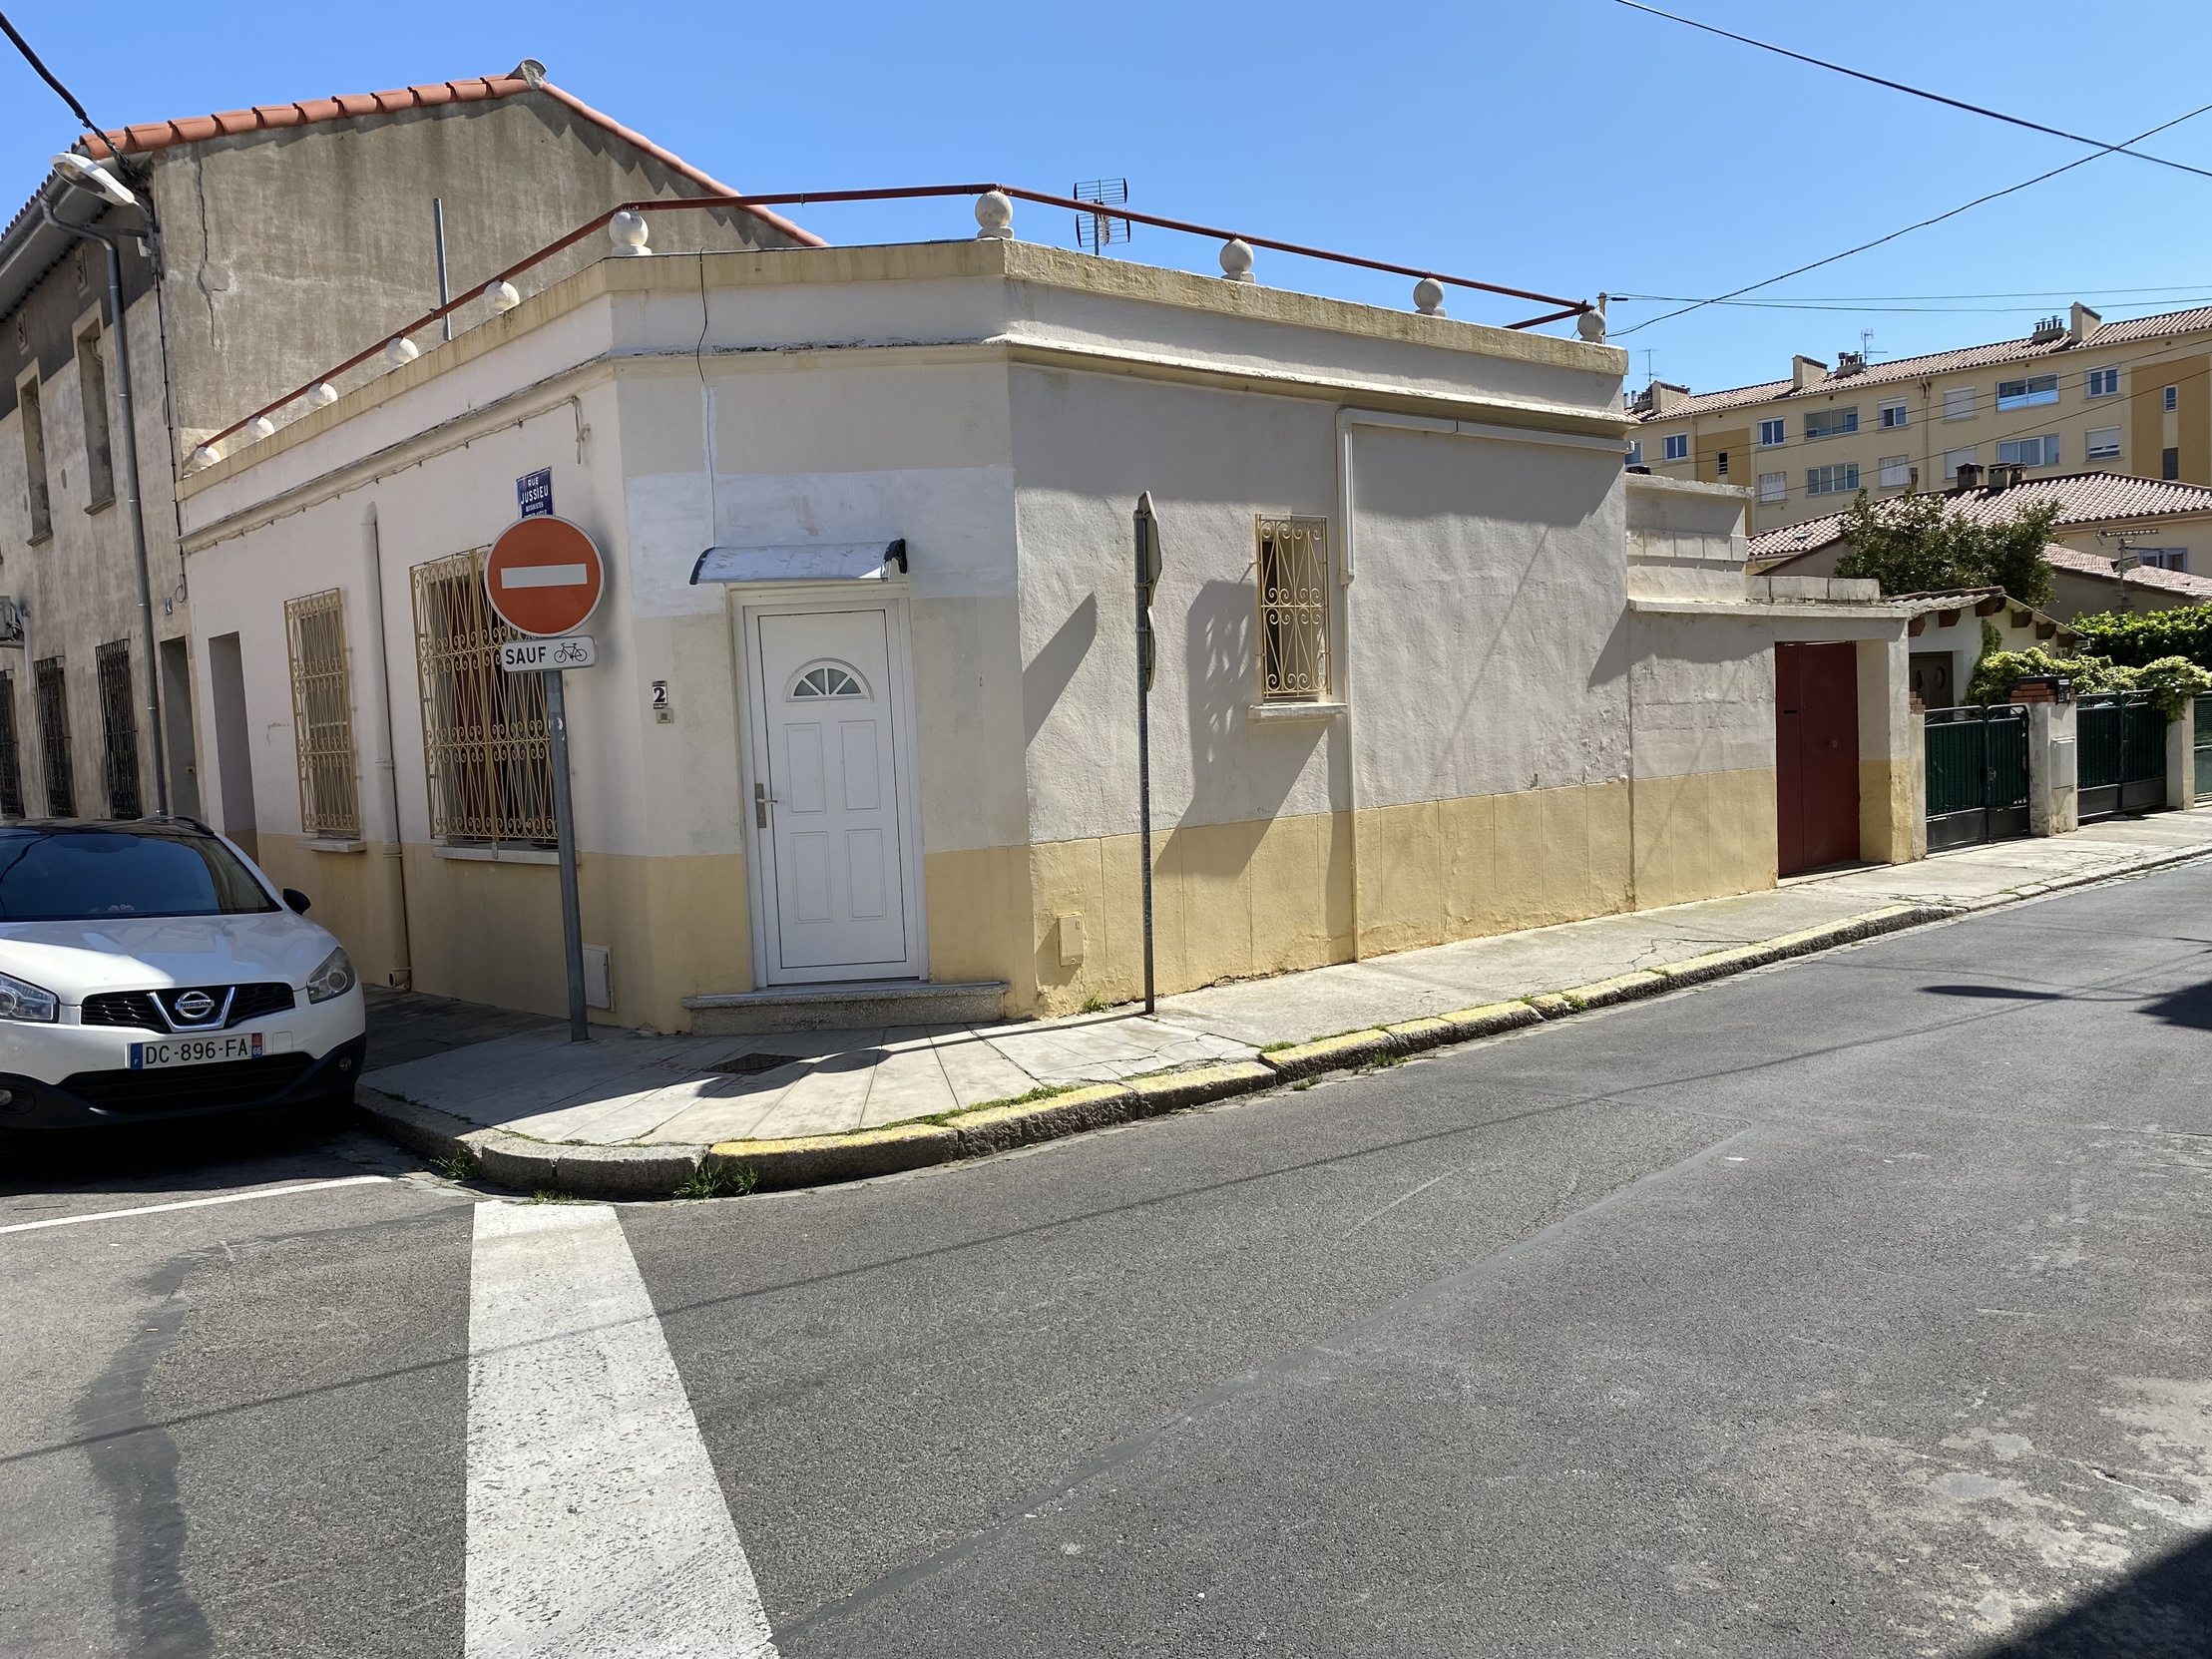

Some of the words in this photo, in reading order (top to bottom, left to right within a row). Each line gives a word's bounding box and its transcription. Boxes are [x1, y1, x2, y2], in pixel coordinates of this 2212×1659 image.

[528, 477, 539, 487] RUE
[521, 484, 549, 505] JUSSIEU
[505, 646, 546, 664] SAUF
[654, 687, 665, 702] 2
[146, 1038, 248, 1064] DC-896-FA
[252, 1046, 262, 1055] 66
